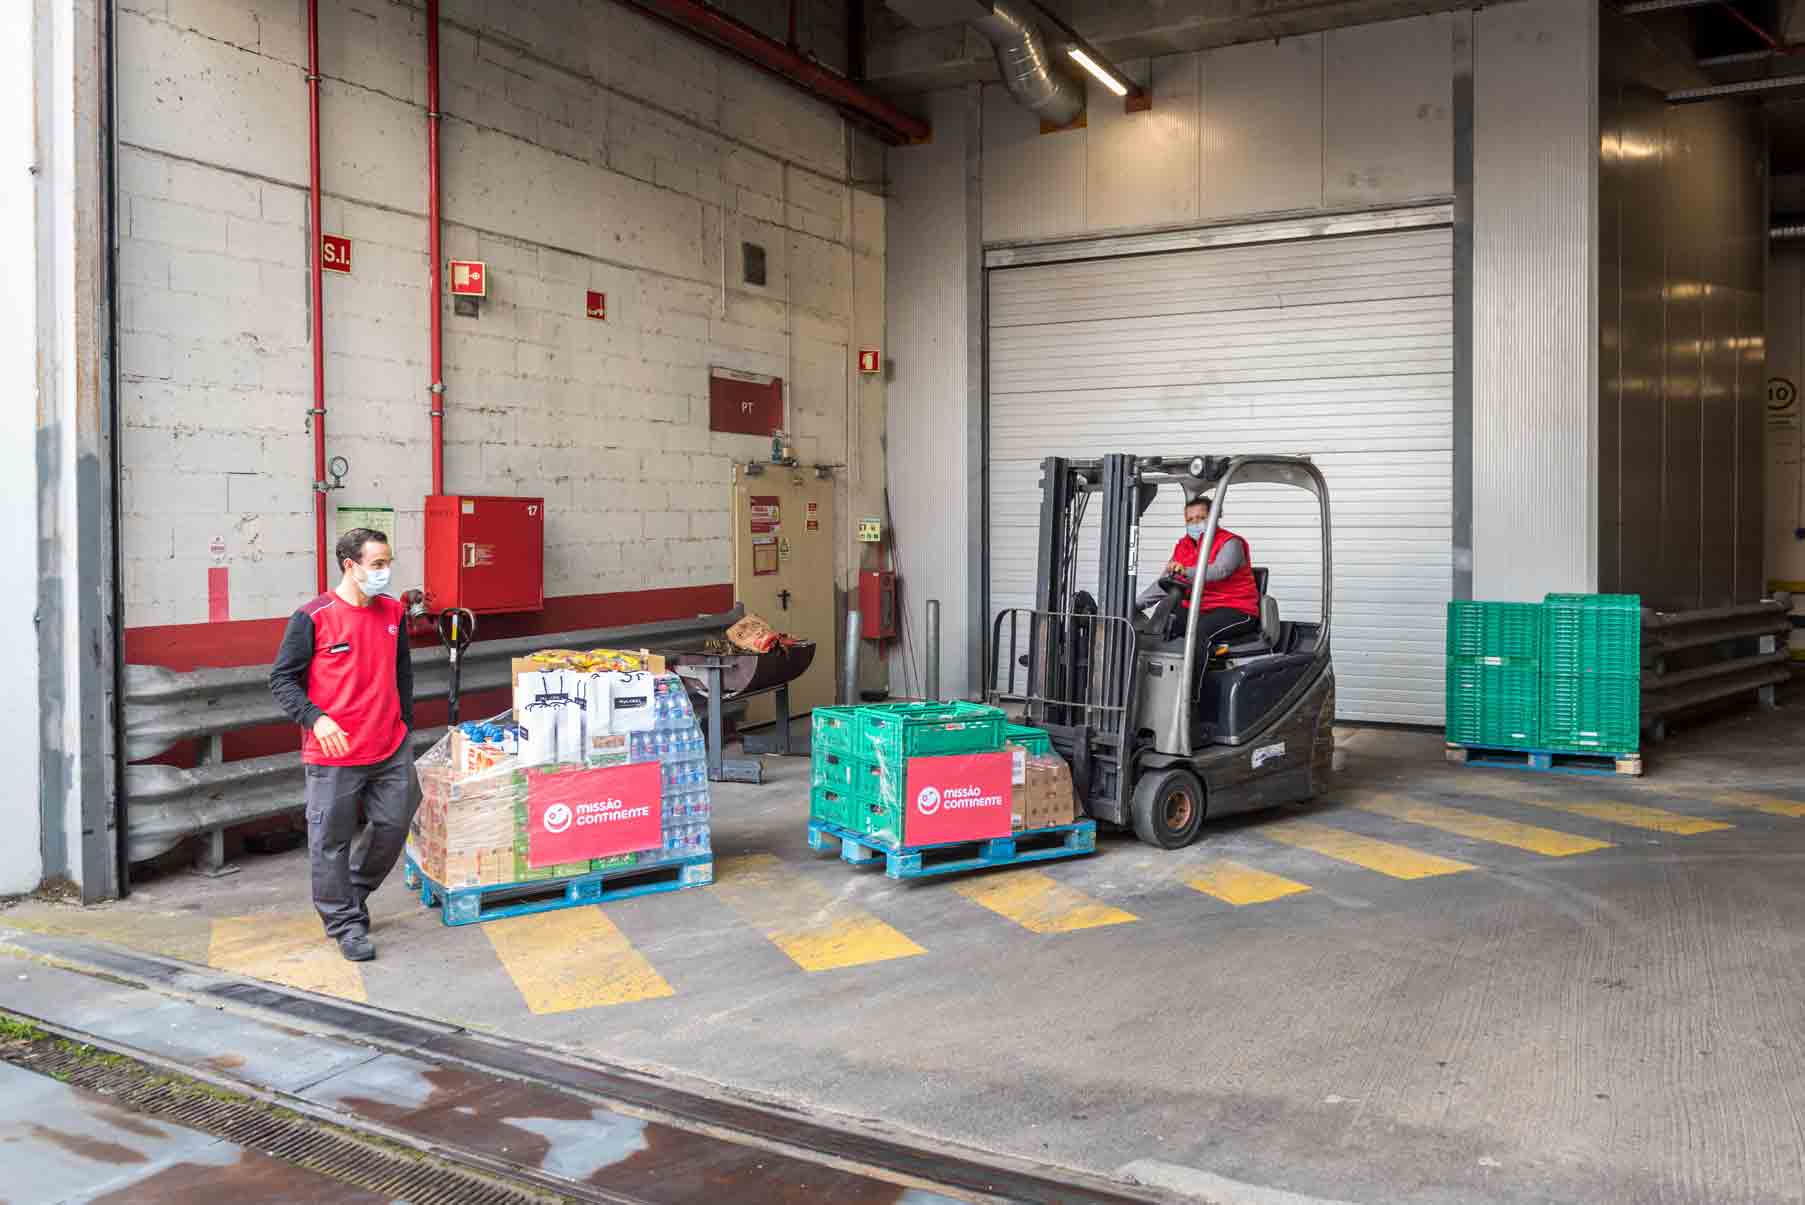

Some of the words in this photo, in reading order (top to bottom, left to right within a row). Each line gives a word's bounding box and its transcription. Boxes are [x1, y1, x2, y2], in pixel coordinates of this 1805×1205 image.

[324, 243, 350, 265] S.I.
[742, 401, 753, 415] PT
[527, 504, 538, 516] 17
